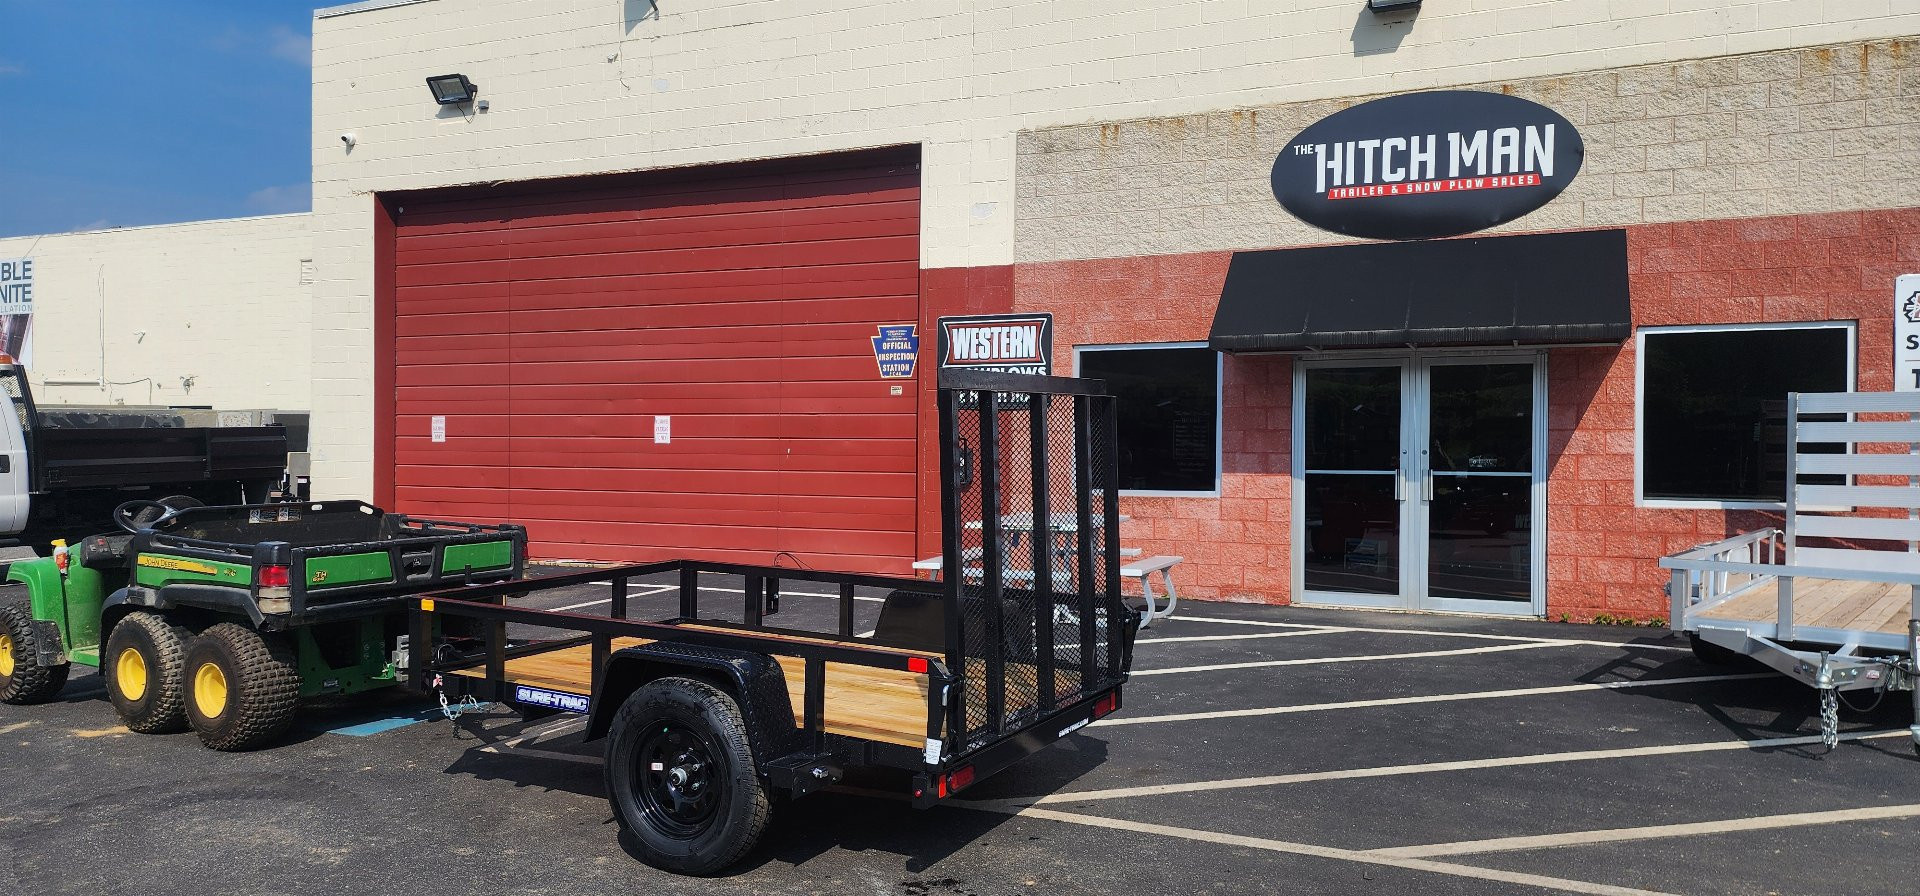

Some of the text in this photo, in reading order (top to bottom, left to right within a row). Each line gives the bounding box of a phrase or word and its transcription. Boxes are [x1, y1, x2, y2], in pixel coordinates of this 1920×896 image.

[1294, 124, 1555, 193] THE HITCH MAN
[1333, 176, 1534, 198] TRAILER & SNOW PLOW SALES
[882, 341, 912, 350] OFFICIAL
[952, 325, 1037, 360] WESTERN
[878, 352, 915, 361] INSPECTION
[882, 363, 910, 372] STATION
[145, 558, 178, 568] JOHN DEERE
[518, 688, 587, 711] SURE-TRAC
